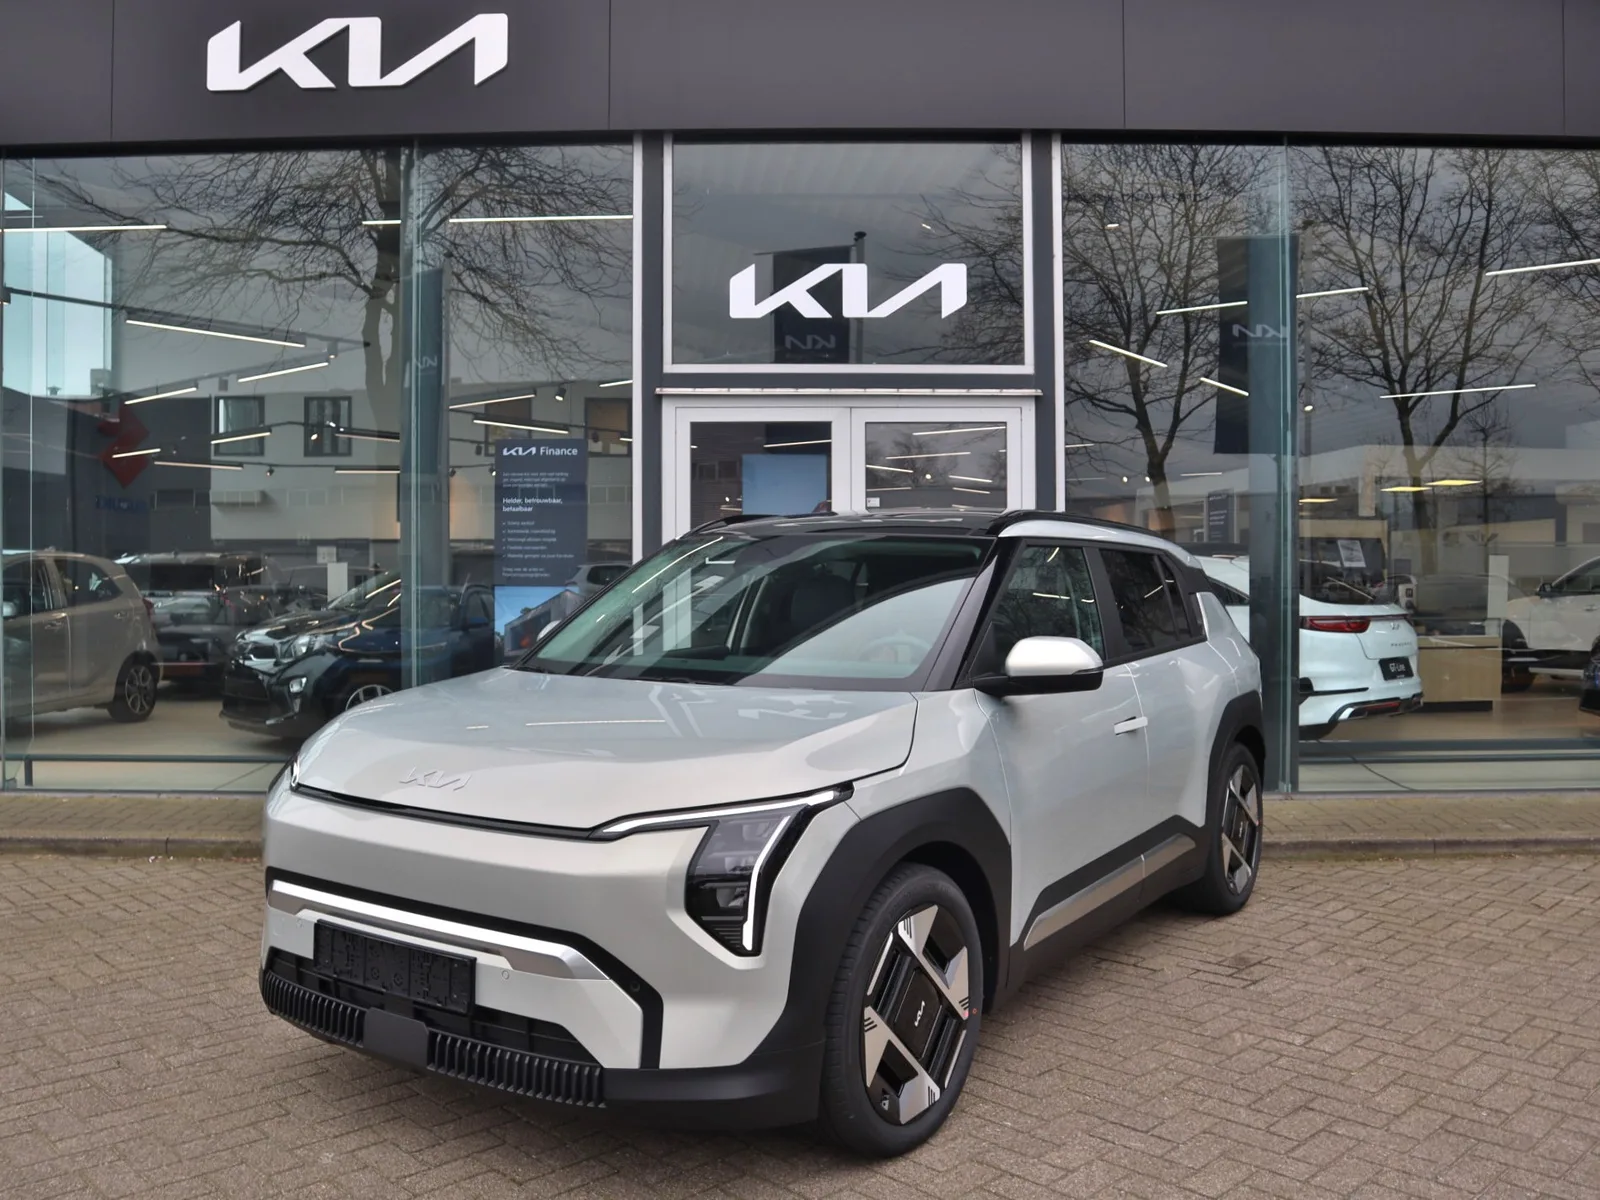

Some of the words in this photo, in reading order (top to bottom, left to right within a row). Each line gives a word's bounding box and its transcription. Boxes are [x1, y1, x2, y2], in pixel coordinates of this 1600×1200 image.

[207, 13, 508, 92] KIA
[729, 263, 967, 319] KIA
[503, 447, 536, 456] KIA
[540, 446, 578, 456] Finance
[398, 766, 472, 791] KIA
